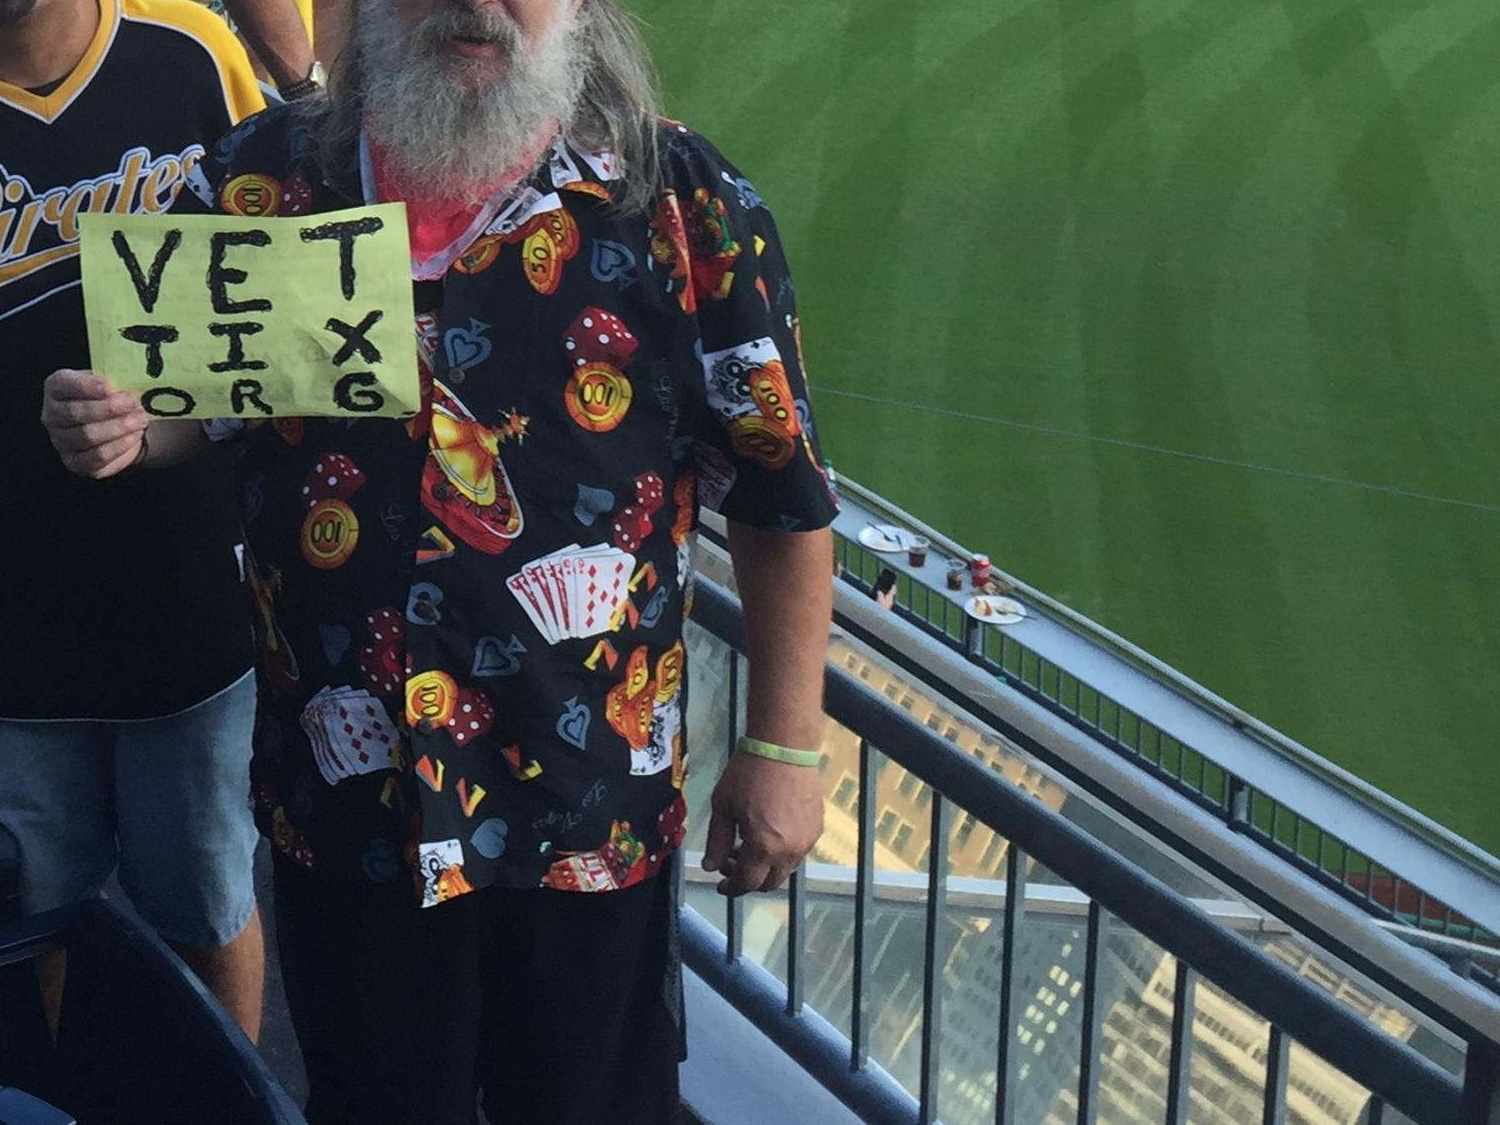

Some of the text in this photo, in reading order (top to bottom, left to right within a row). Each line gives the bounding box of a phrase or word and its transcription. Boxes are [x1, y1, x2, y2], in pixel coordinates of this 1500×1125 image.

[111, 216, 384, 314] VET
[119, 310, 383, 379] TIX
[141, 371, 385, 418] ORG
